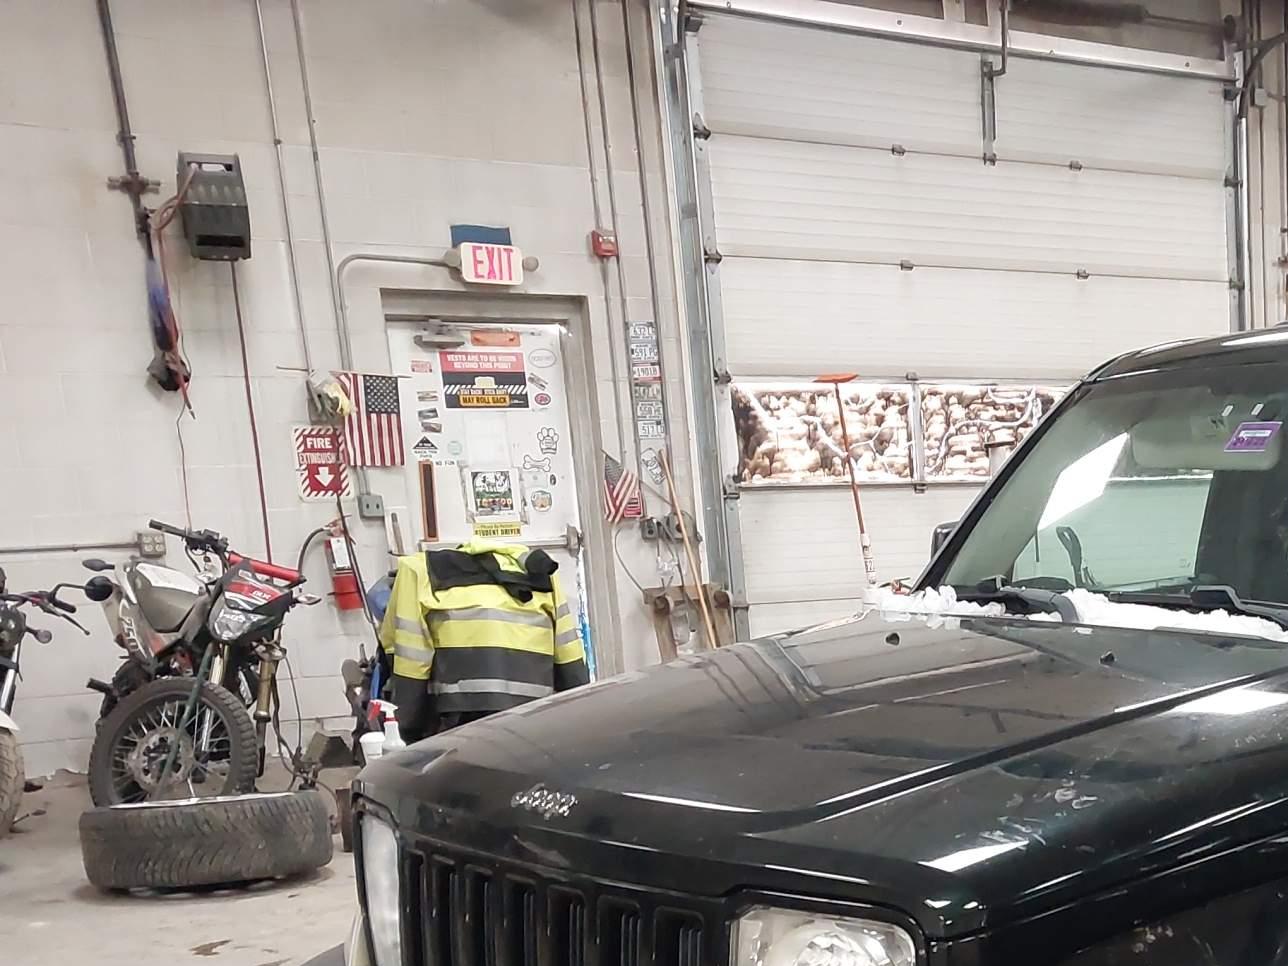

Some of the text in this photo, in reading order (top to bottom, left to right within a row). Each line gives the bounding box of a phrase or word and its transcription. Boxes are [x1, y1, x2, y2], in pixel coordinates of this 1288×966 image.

[472, 246, 513, 281] EXIT
[467, 354, 479, 362] ARE
[480, 354, 488, 362] TO
[462, 396, 474, 404] MAY
[476, 396, 491, 404] ROLL
[492, 396, 507, 404] BACK
[306, 437, 332, 449] FIRE
